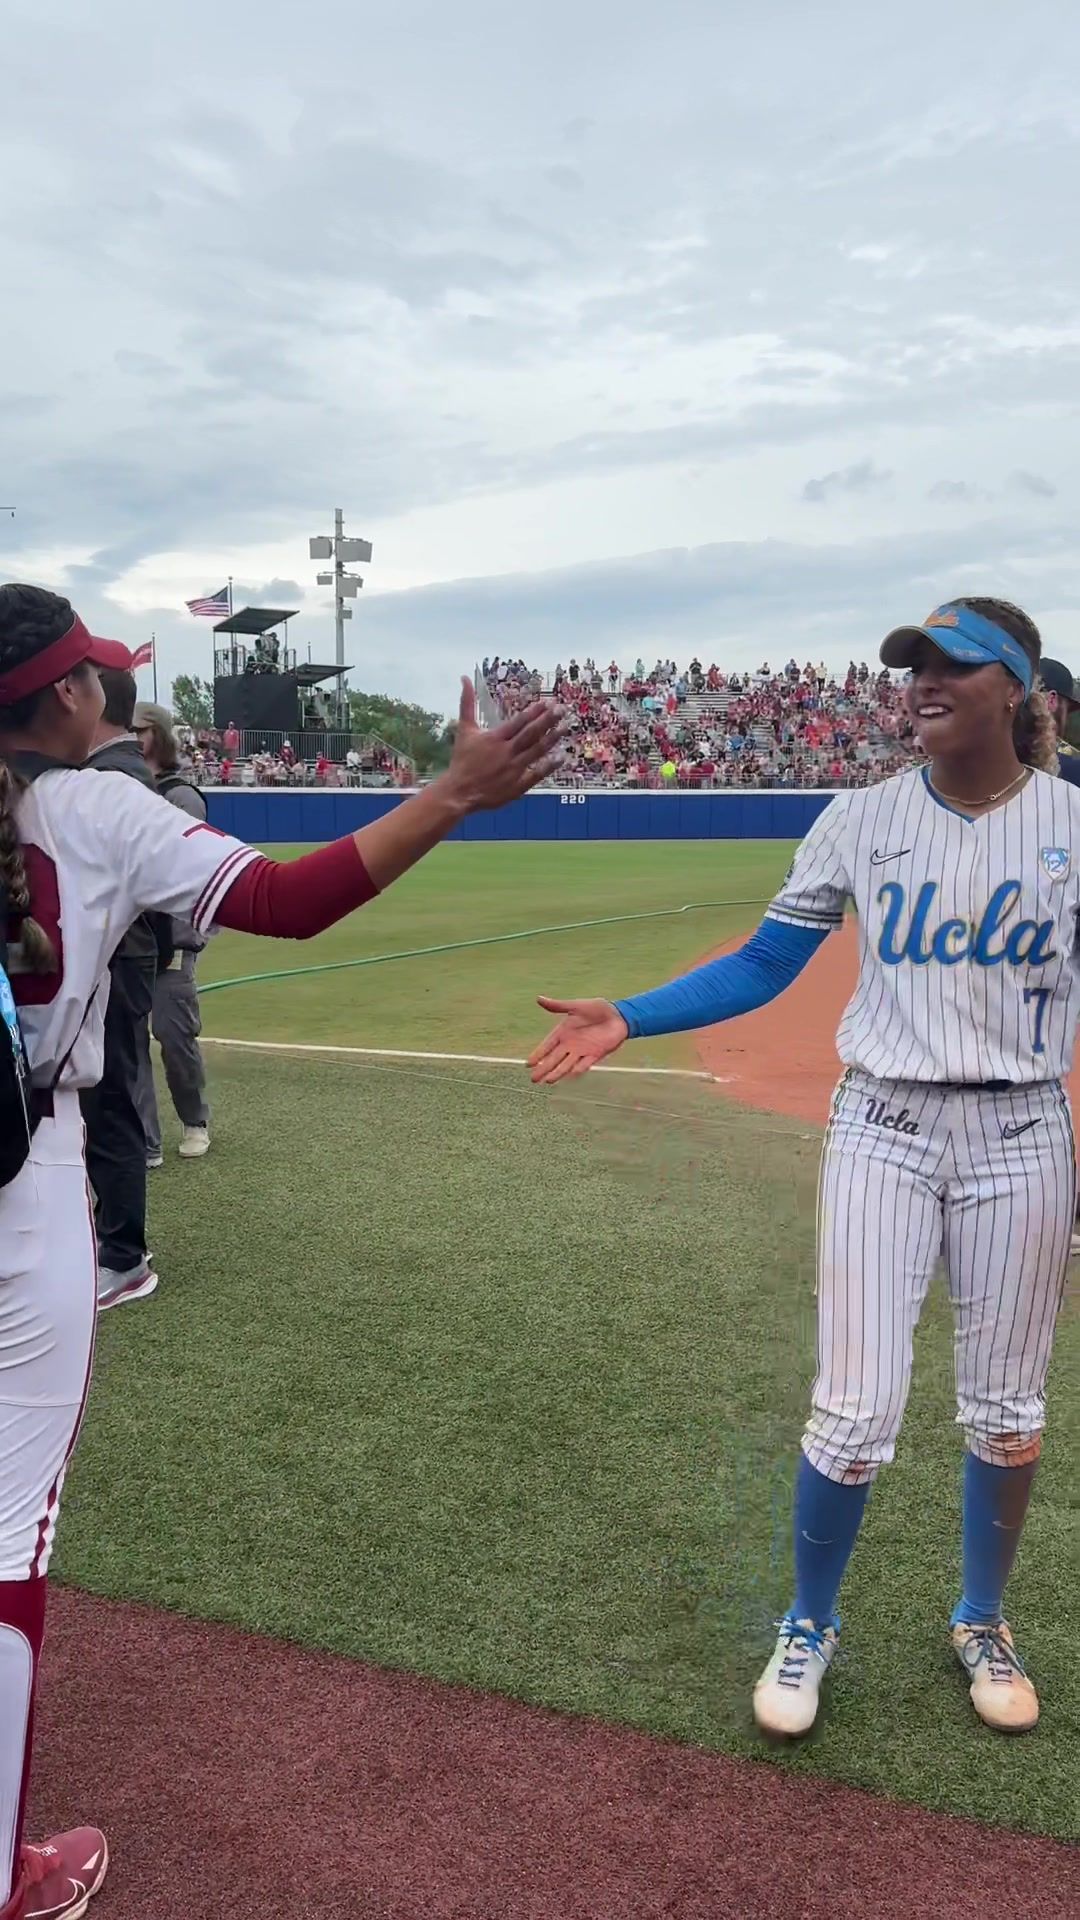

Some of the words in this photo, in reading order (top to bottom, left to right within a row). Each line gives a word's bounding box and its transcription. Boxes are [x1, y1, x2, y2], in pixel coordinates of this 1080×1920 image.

[560, 794, 586, 805] 220
[878, 881, 1057, 967] Ucla
[1024, 987, 1052, 1055] 7
[865, 1098, 921, 1136] Ucla
